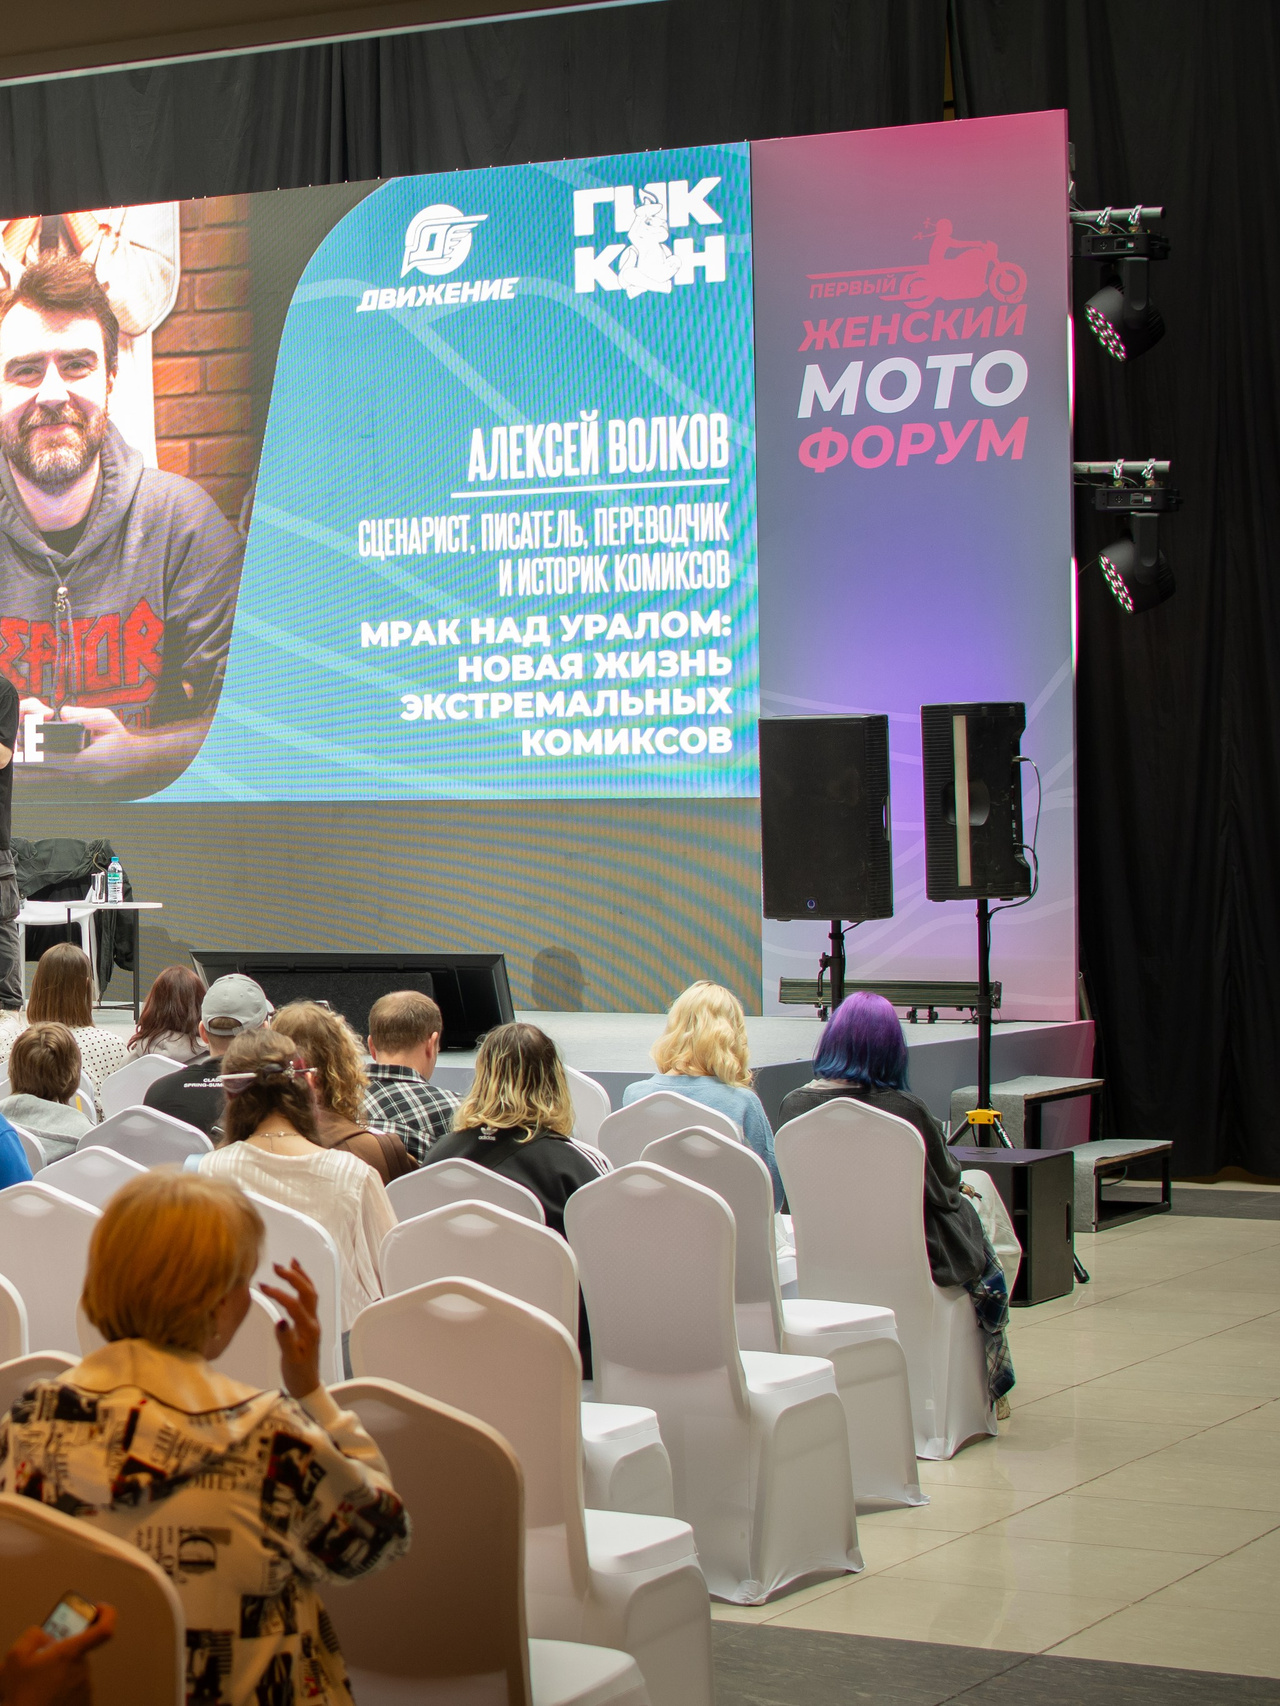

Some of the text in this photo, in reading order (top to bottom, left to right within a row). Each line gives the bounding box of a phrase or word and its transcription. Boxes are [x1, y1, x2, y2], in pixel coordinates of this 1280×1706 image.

[574, 234, 726, 298] КН
[809, 274, 897, 299] ПЕРВЫЙ
[356, 277, 519, 313] ДВИЖЕНИЕ
[797, 349, 1029, 419] МОТО
[468, 410, 730, 482] АЛЕКСЕЙ ВОЛКОВ
[797, 416, 1030, 474] ФОРУМ
[358, 502, 731, 561] СЦЕНАРИСТ, ПИСАТЕЛЬ, ПЕРЕВОДЧИК
[499, 550, 731, 597] И ИСТОРИК КОМИКСОВ
[360, 610, 732, 648] МРАК НАД УРАЛОМ:
[458, 649, 733, 682] НОВАЯ ЖИЗНЬ
[400, 687, 734, 721] ЭКСТРЕМАЛЬНЫХ
[521, 726, 733, 756] КОМИКСОВ
